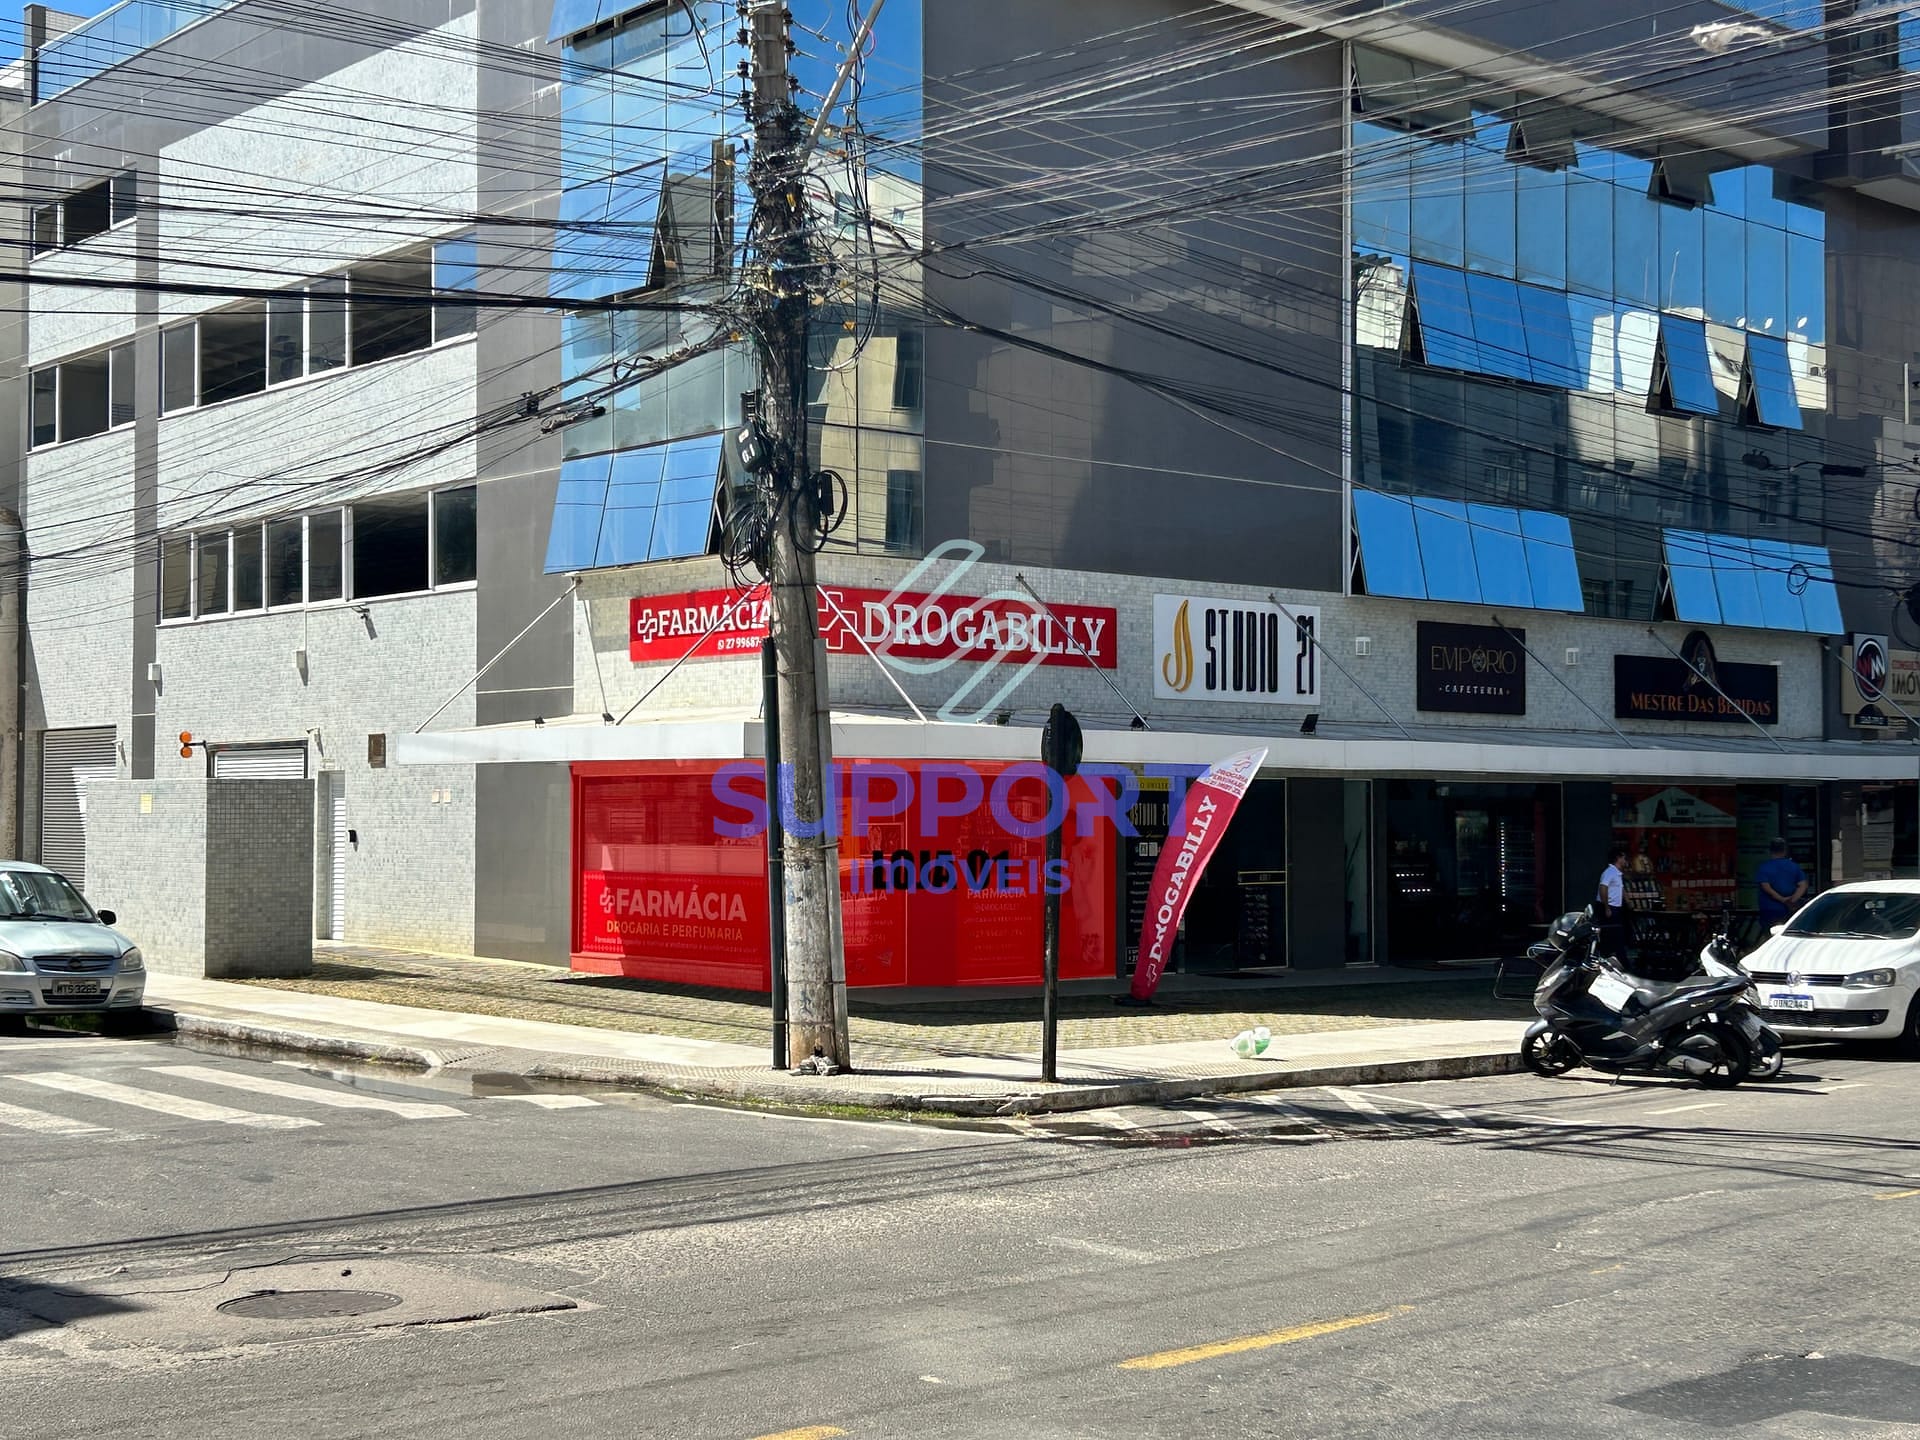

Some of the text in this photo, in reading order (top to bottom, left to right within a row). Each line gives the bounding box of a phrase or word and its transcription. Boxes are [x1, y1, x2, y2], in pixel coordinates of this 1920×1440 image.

[657, 595, 771, 637] FARMÁCIA
[862, 602, 1106, 657] DROGABILLY
[725, 639, 736, 650] 27
[1205, 608, 1314, 695] STUDIO 21
[1431, 645, 1517, 674] EMPÓRIO
[1445, 684, 1504, 696] CAFETERIA
[1149, 794, 1218, 963] DROGABILLY
[616, 884, 748, 922] FARMÁCIA
[606, 919, 743, 941] DROGARIA E PERFUMARIA
